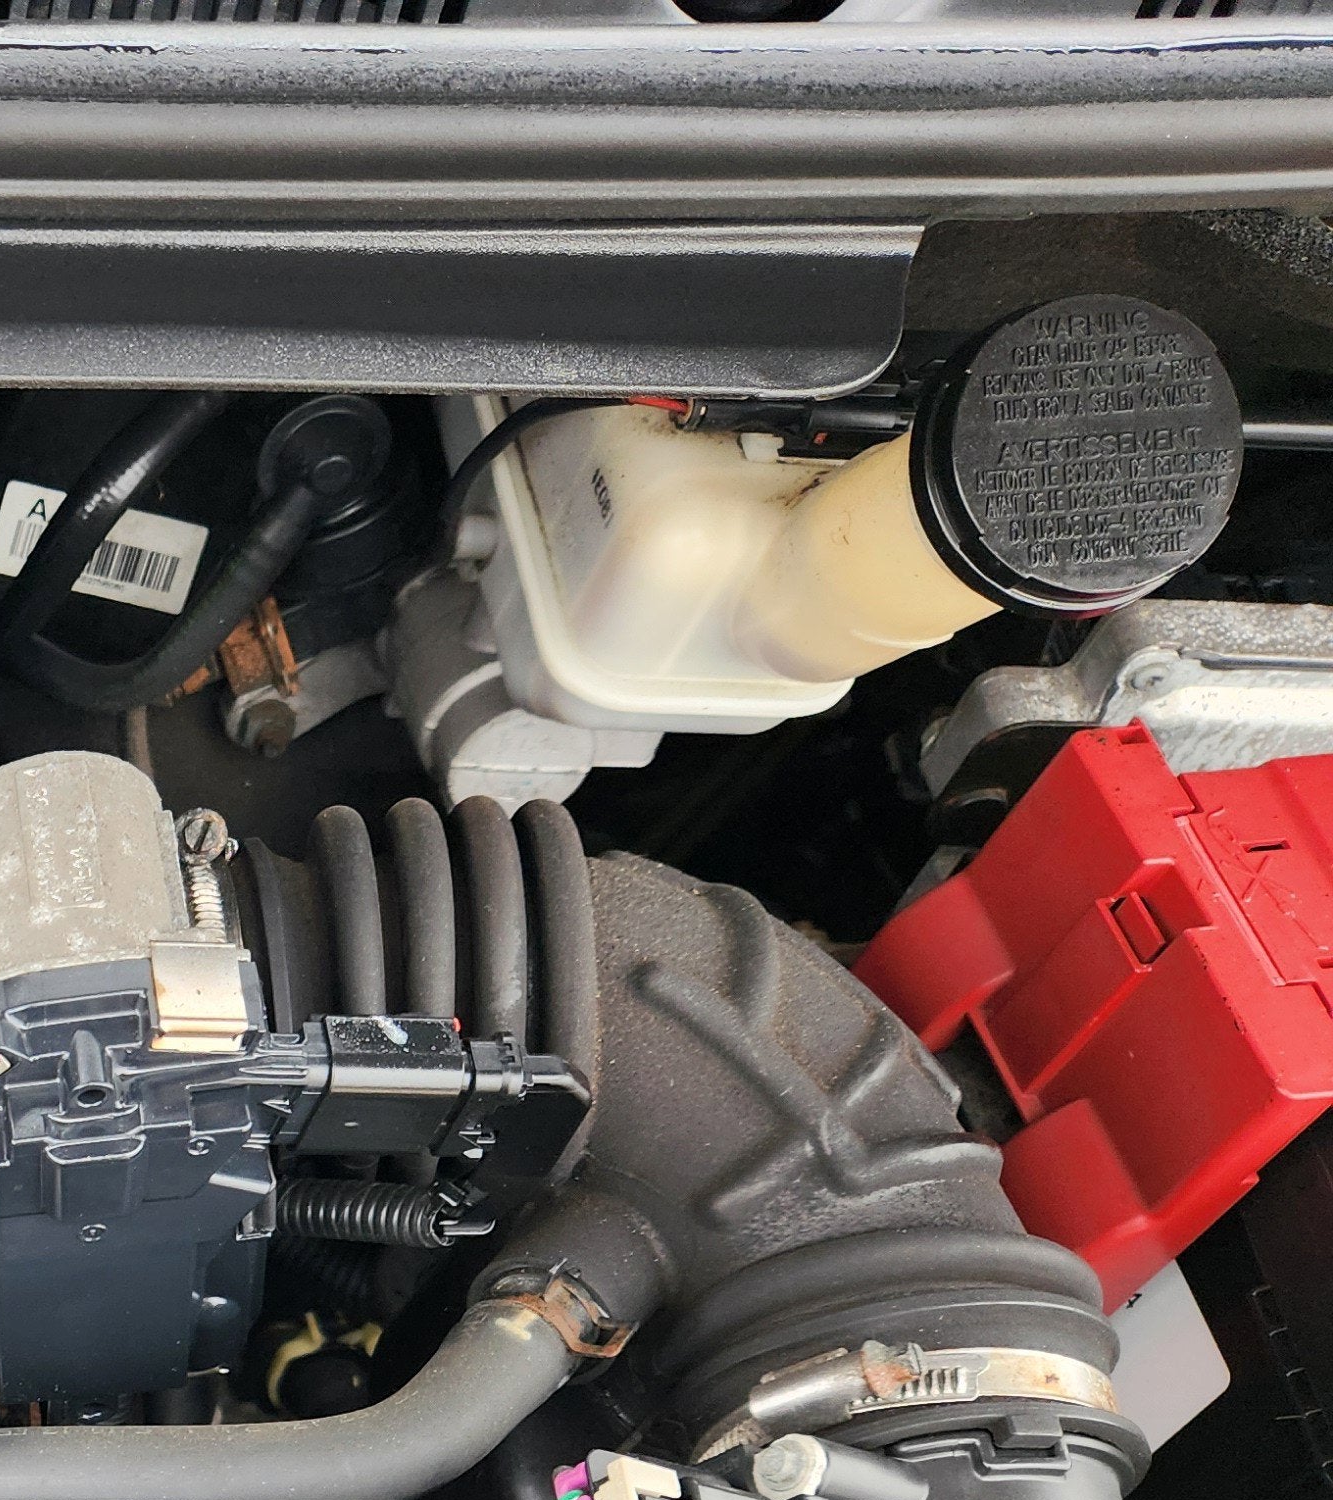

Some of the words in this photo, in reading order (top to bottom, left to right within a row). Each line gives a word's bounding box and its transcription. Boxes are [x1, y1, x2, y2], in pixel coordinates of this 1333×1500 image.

[1033, 310, 1151, 339] WARNING
[998, 424, 1202, 467] AVERTISSEMENT
[27, 497, 48, 522] A
